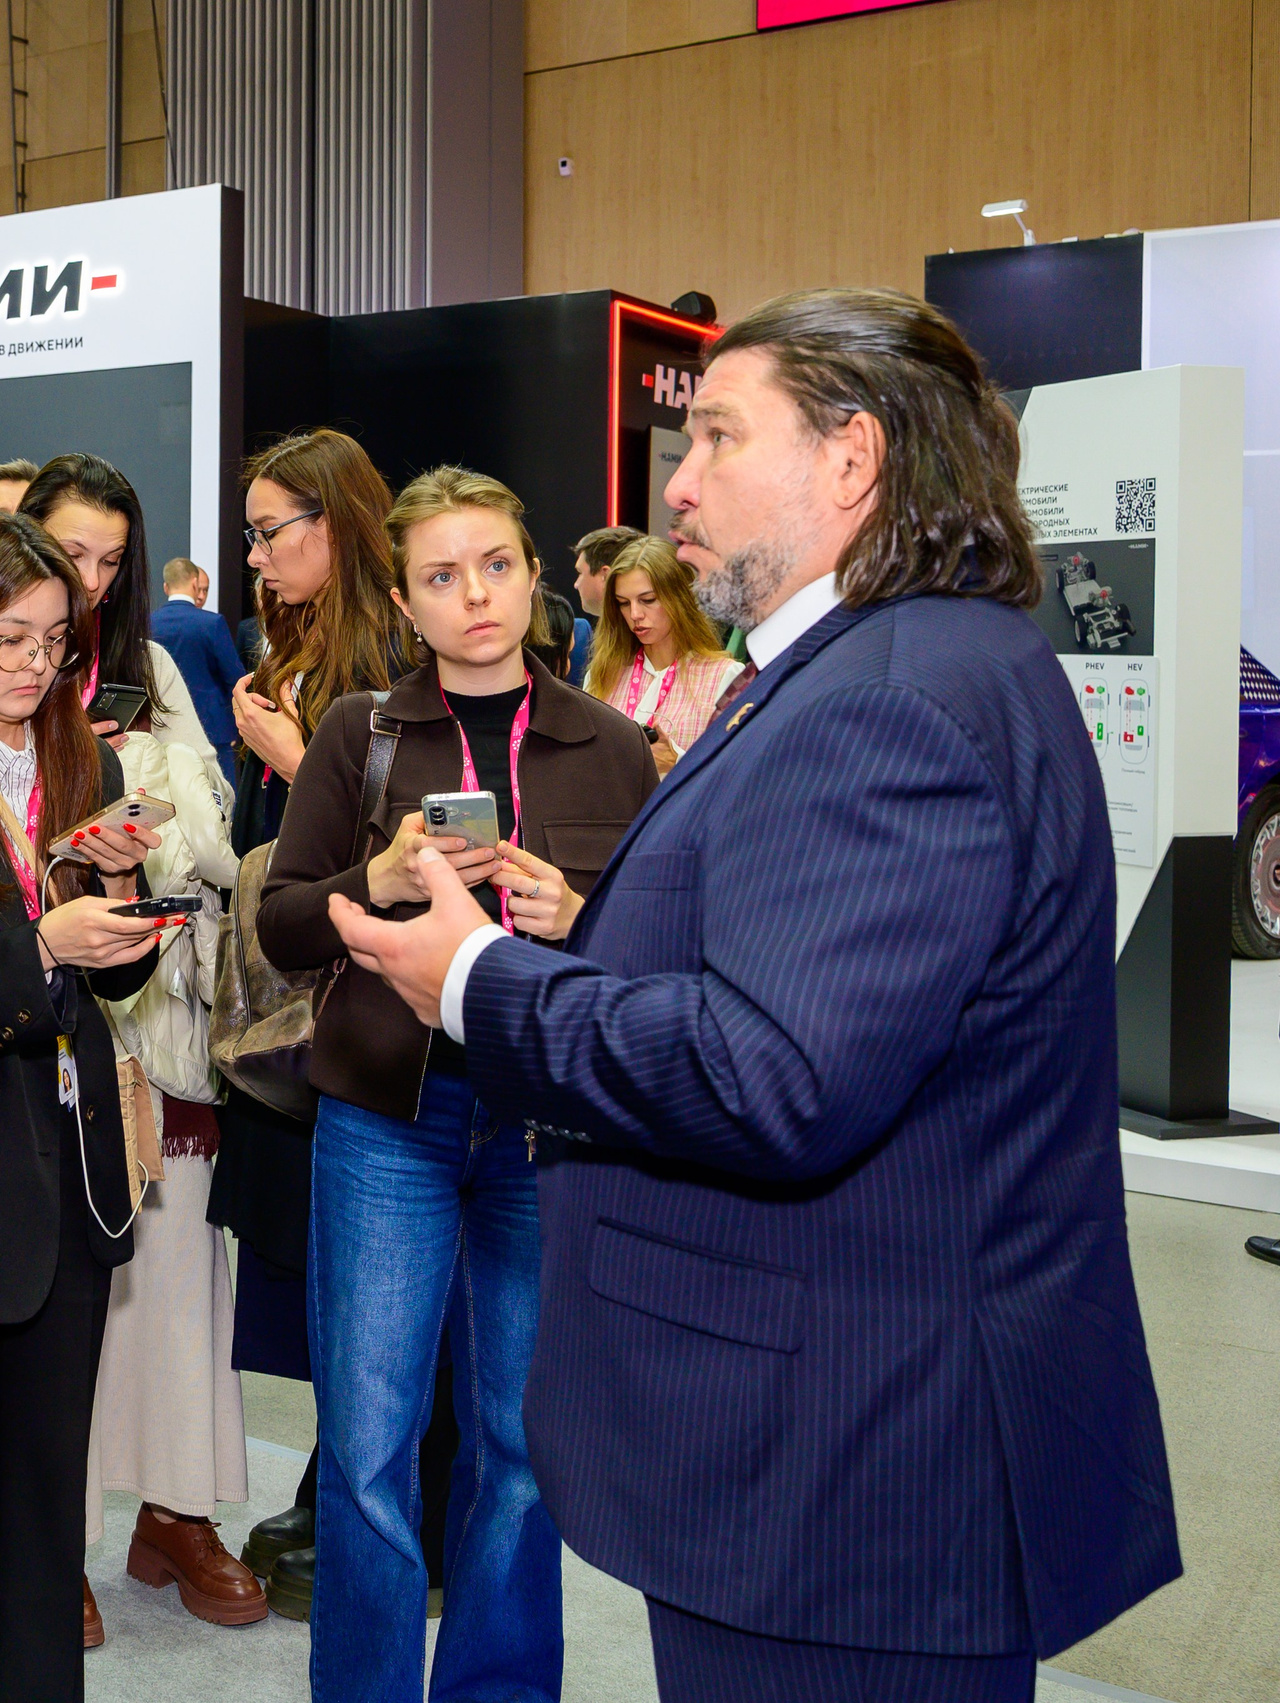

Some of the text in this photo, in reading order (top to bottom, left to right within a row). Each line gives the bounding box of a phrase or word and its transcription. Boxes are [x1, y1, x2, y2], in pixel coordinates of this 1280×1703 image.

[8, 336, 84, 357] ДВИЖЕНИИ
[654, 364, 704, 411] НА
[1018, 484, 1069, 495] ЕКТРИЧЕСКИЕ
[1021, 496, 1058, 506] ОМОБИЛИ
[1027, 507, 1065, 517] ОМОБИЛИ
[1034, 518, 1070, 527] ОРОДНЫХ
[1053, 527, 1098, 538] ЭЛЕМЕНТАХ
[1085, 662, 1143, 671] PHEV HEV
